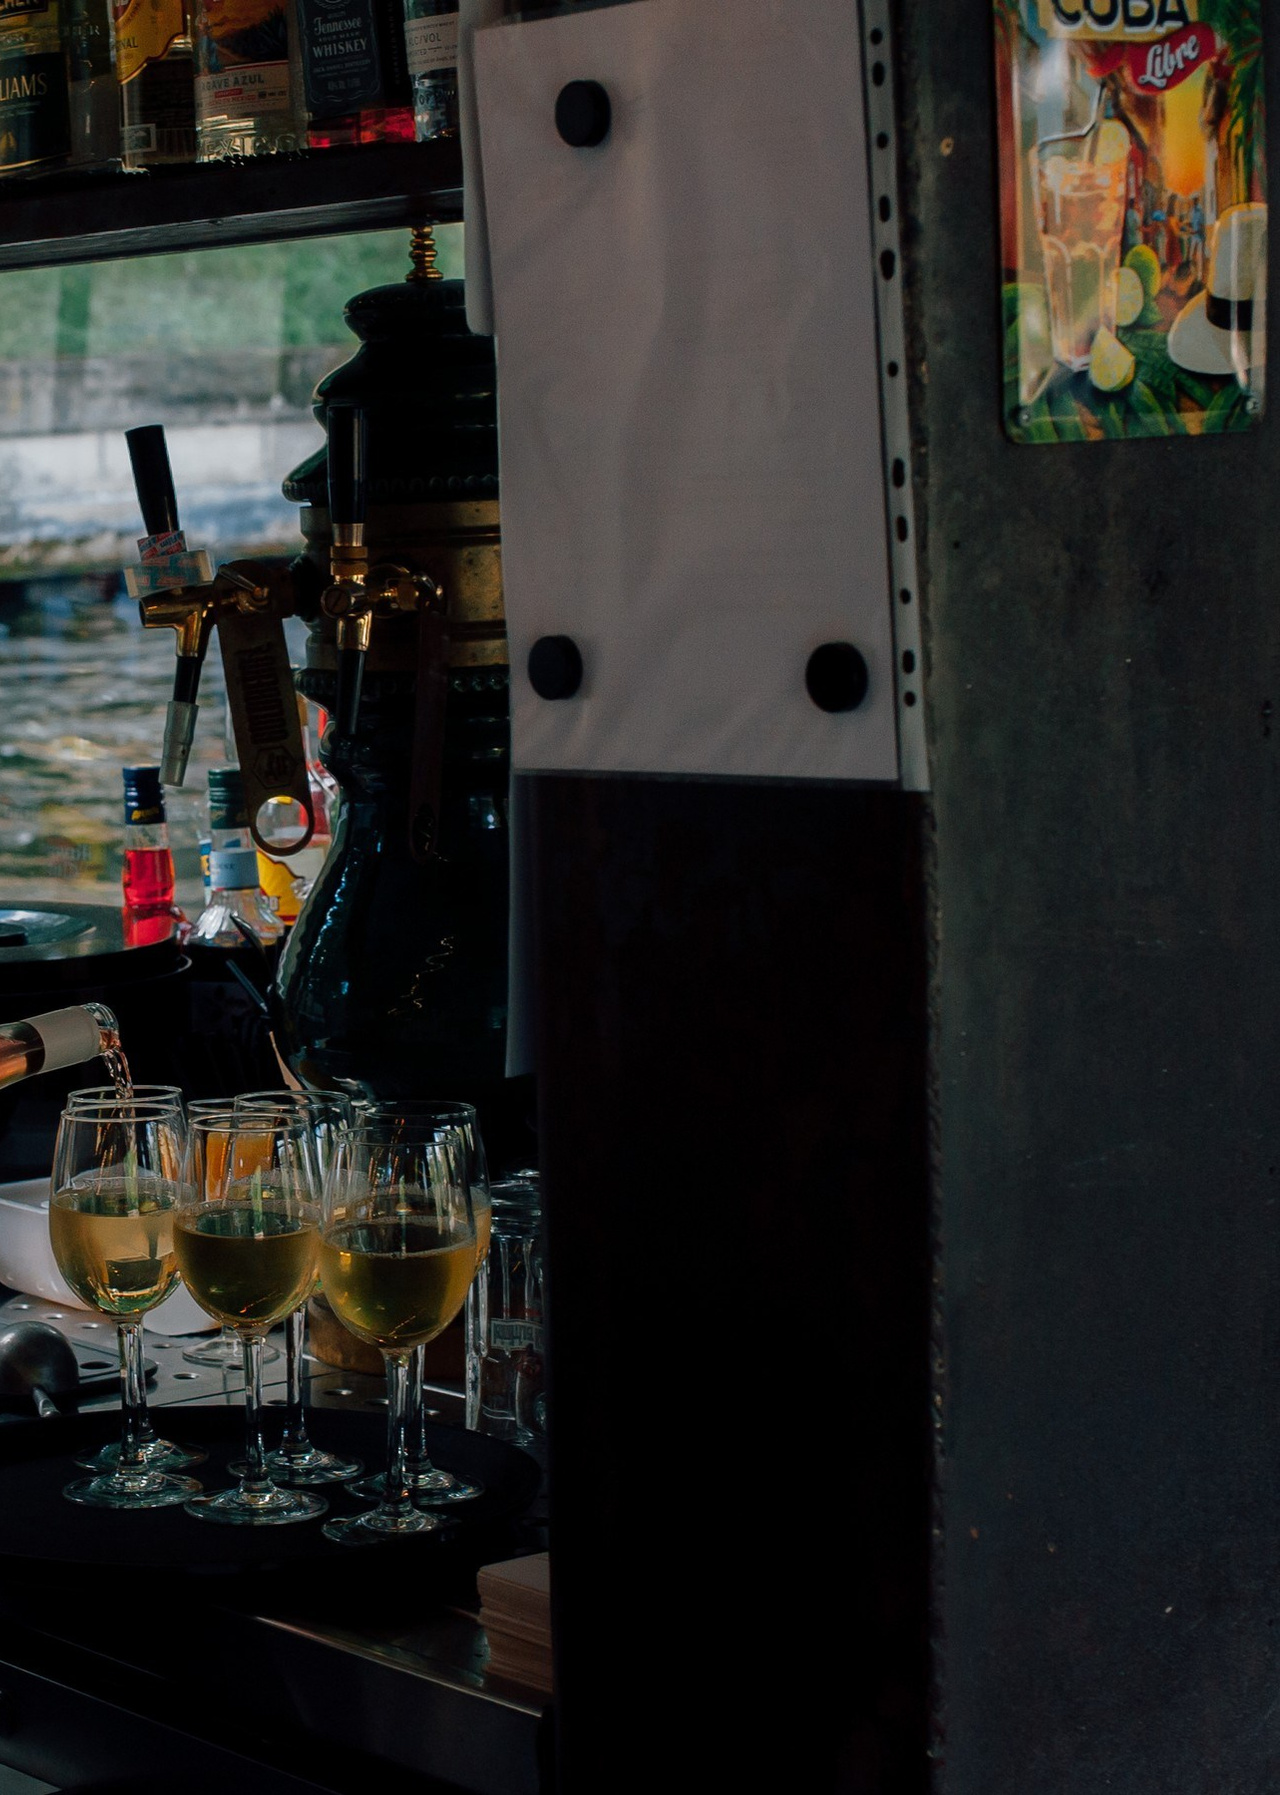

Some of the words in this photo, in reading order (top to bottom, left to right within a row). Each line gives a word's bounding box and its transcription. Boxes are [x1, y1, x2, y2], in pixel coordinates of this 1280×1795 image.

[313, 16, 363, 36] Tennessee
[312, 37, 368, 59] WHISKEY
[1137, 34, 1201, 89] Libre
[233, 74, 264, 87] AZUL
